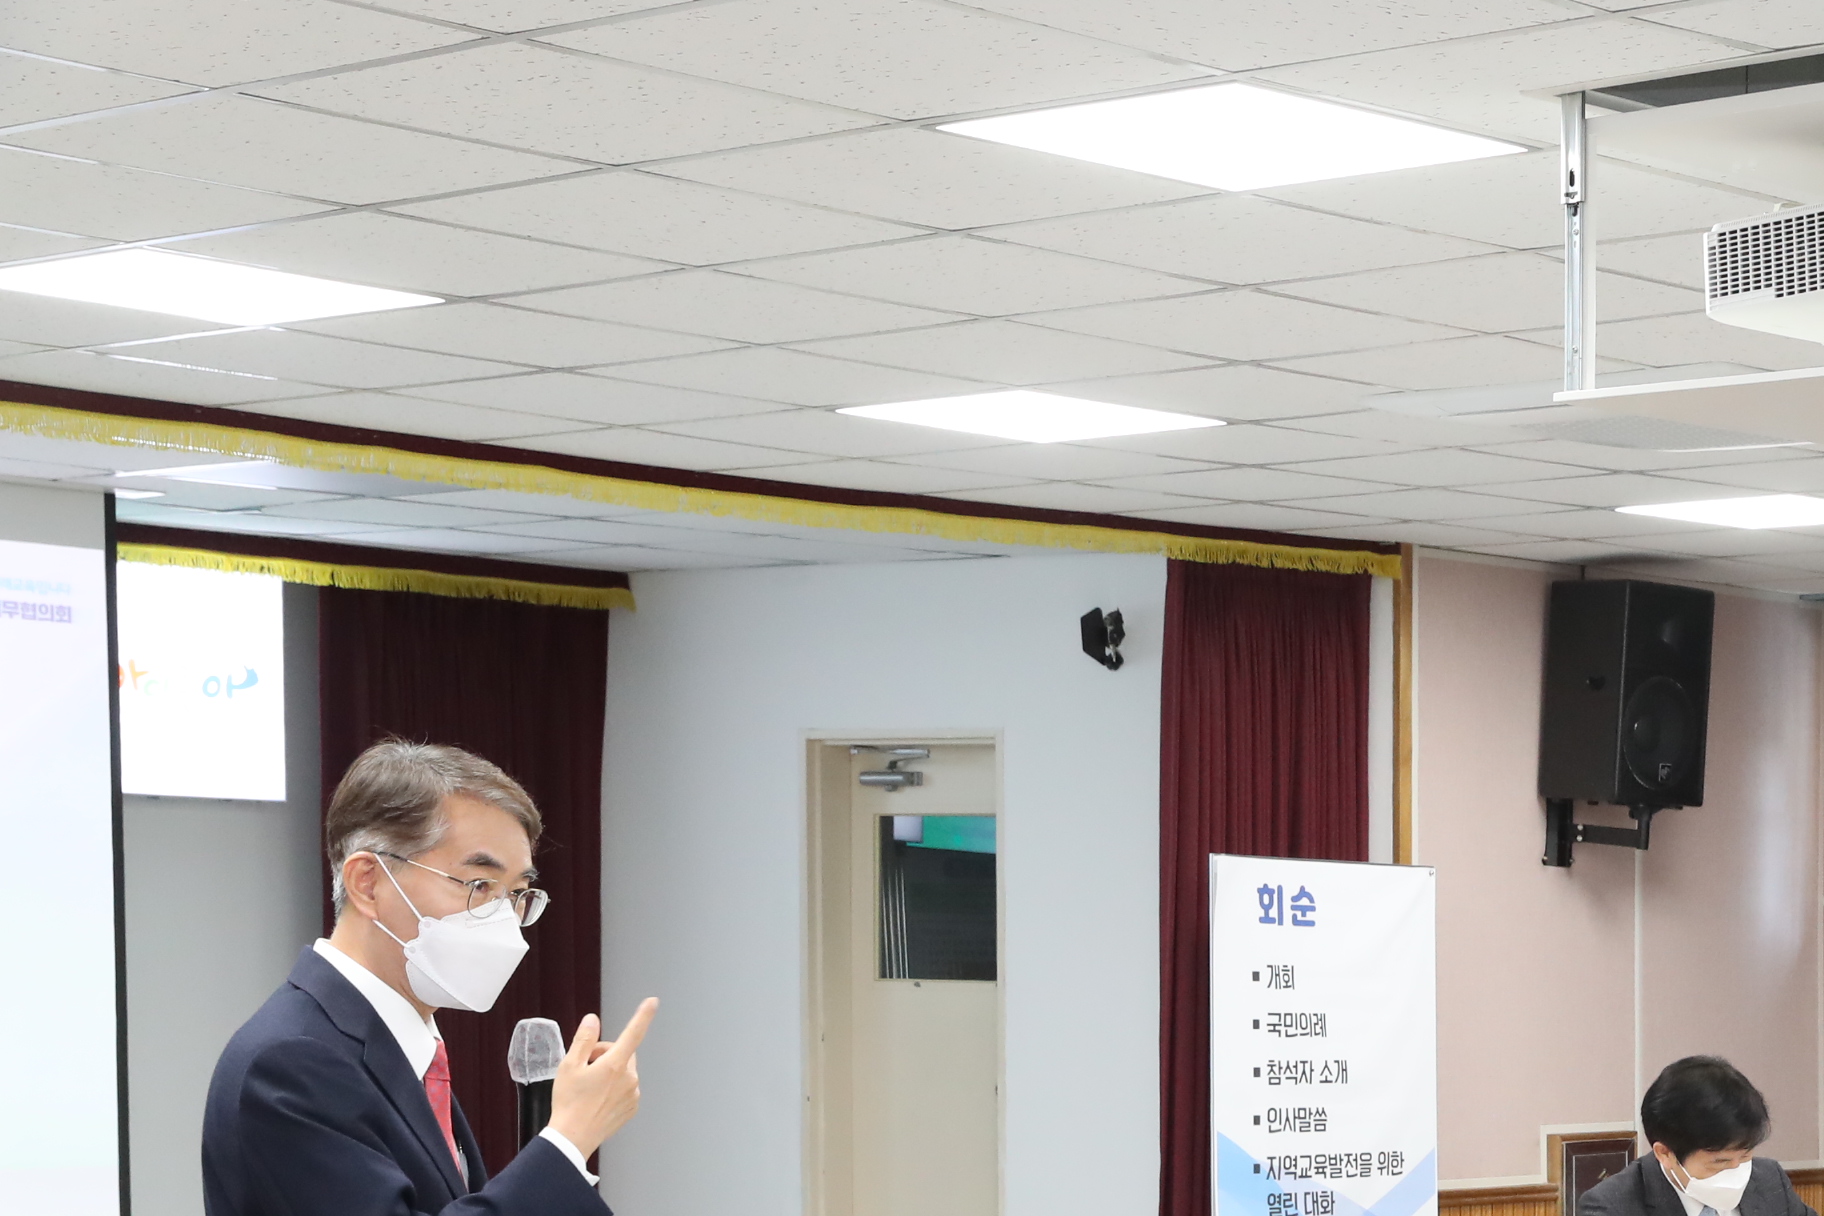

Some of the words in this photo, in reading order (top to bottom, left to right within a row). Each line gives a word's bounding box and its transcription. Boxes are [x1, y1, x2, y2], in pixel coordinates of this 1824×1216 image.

[0, 600, 72, 623] 무협의회
[1266, 964, 1295, 990] 개회
[1266, 1012, 1327, 1038] 국민의례
[1266, 1061, 1314, 1086] 참석자
[1319, 1060, 1348, 1085] 소개
[1266, 1107, 1327, 1133] 인사말씀
[1266, 1153, 1372, 1181] 지역교육발전을
[1377, 1151, 1404, 1176] 위한
[1304, 1191, 1335, 1216] 대화
